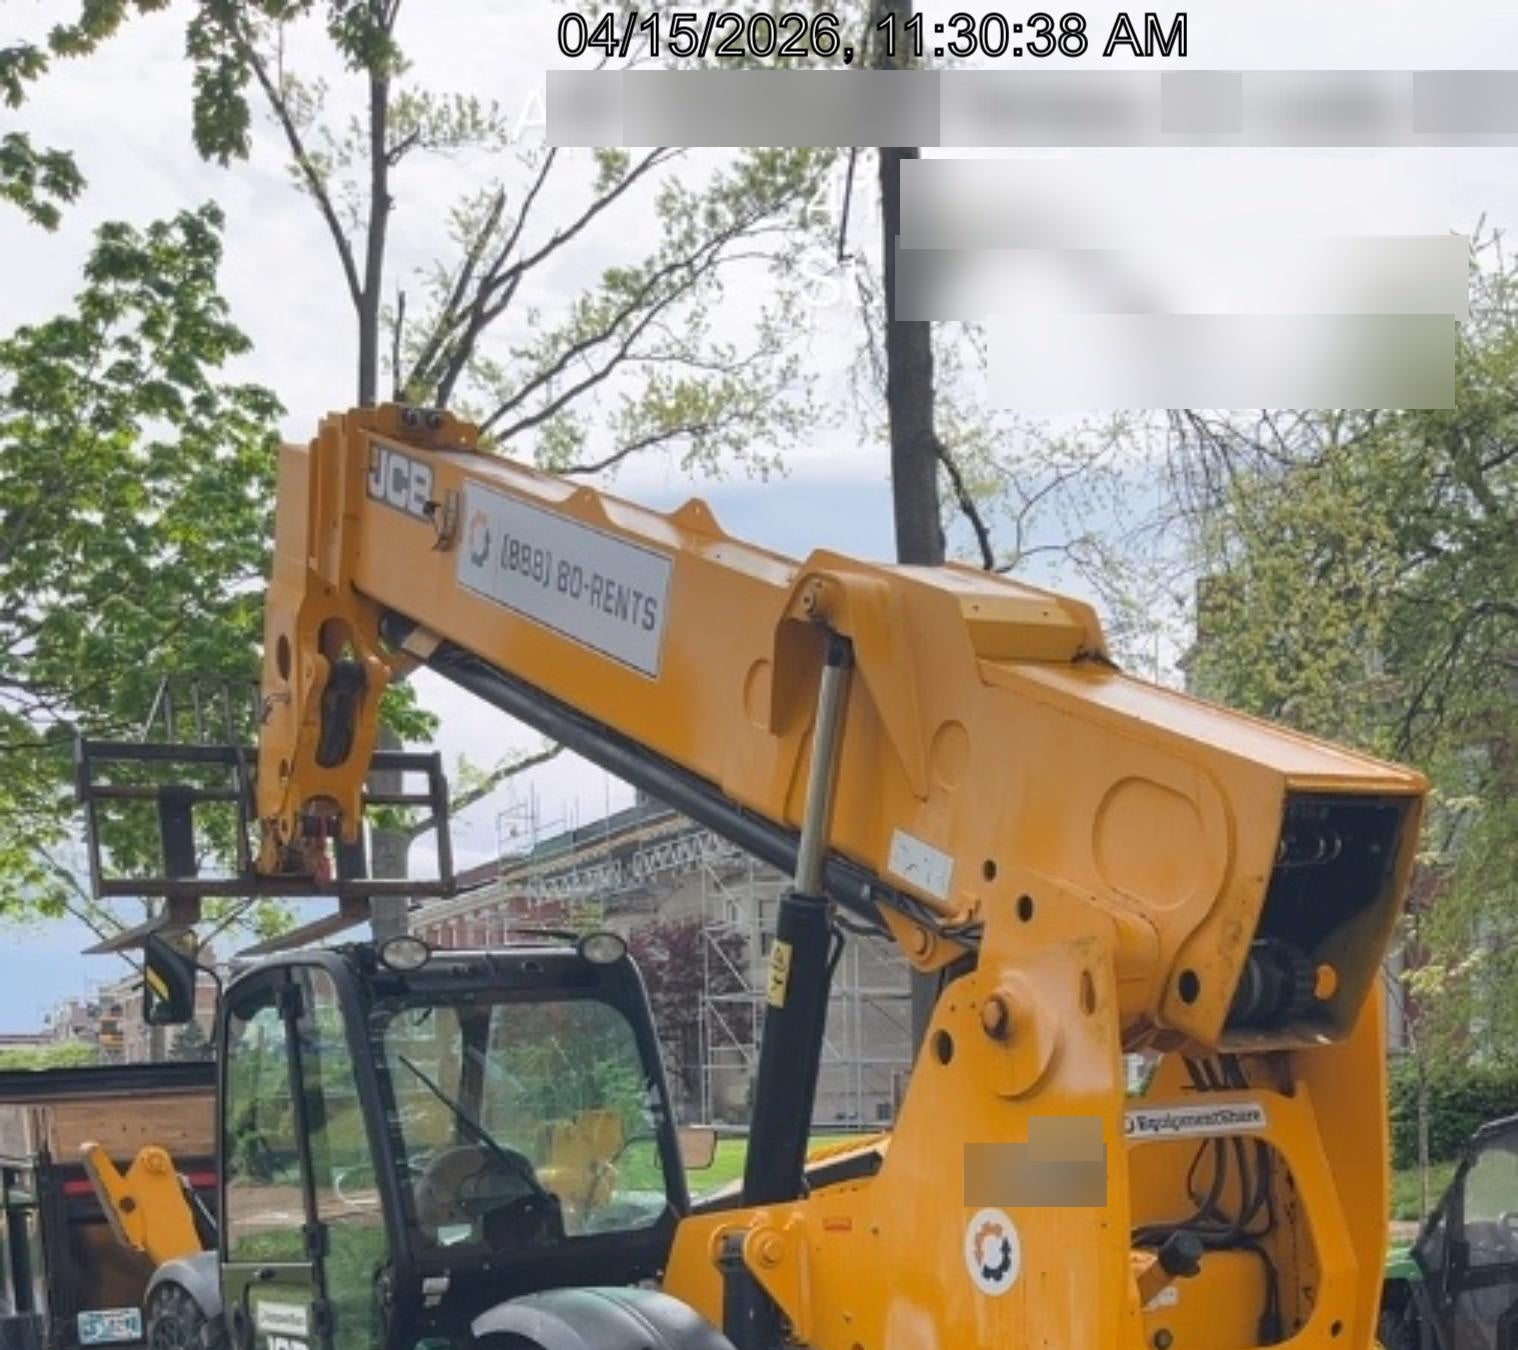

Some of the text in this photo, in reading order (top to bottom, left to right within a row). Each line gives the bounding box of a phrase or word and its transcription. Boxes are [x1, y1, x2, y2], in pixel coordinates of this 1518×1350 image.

[368, 449, 433, 517] JCB
[501, 533, 657, 631] (888) 80-RENTS
[1136, 1110, 1260, 1131] EquipmentShare
